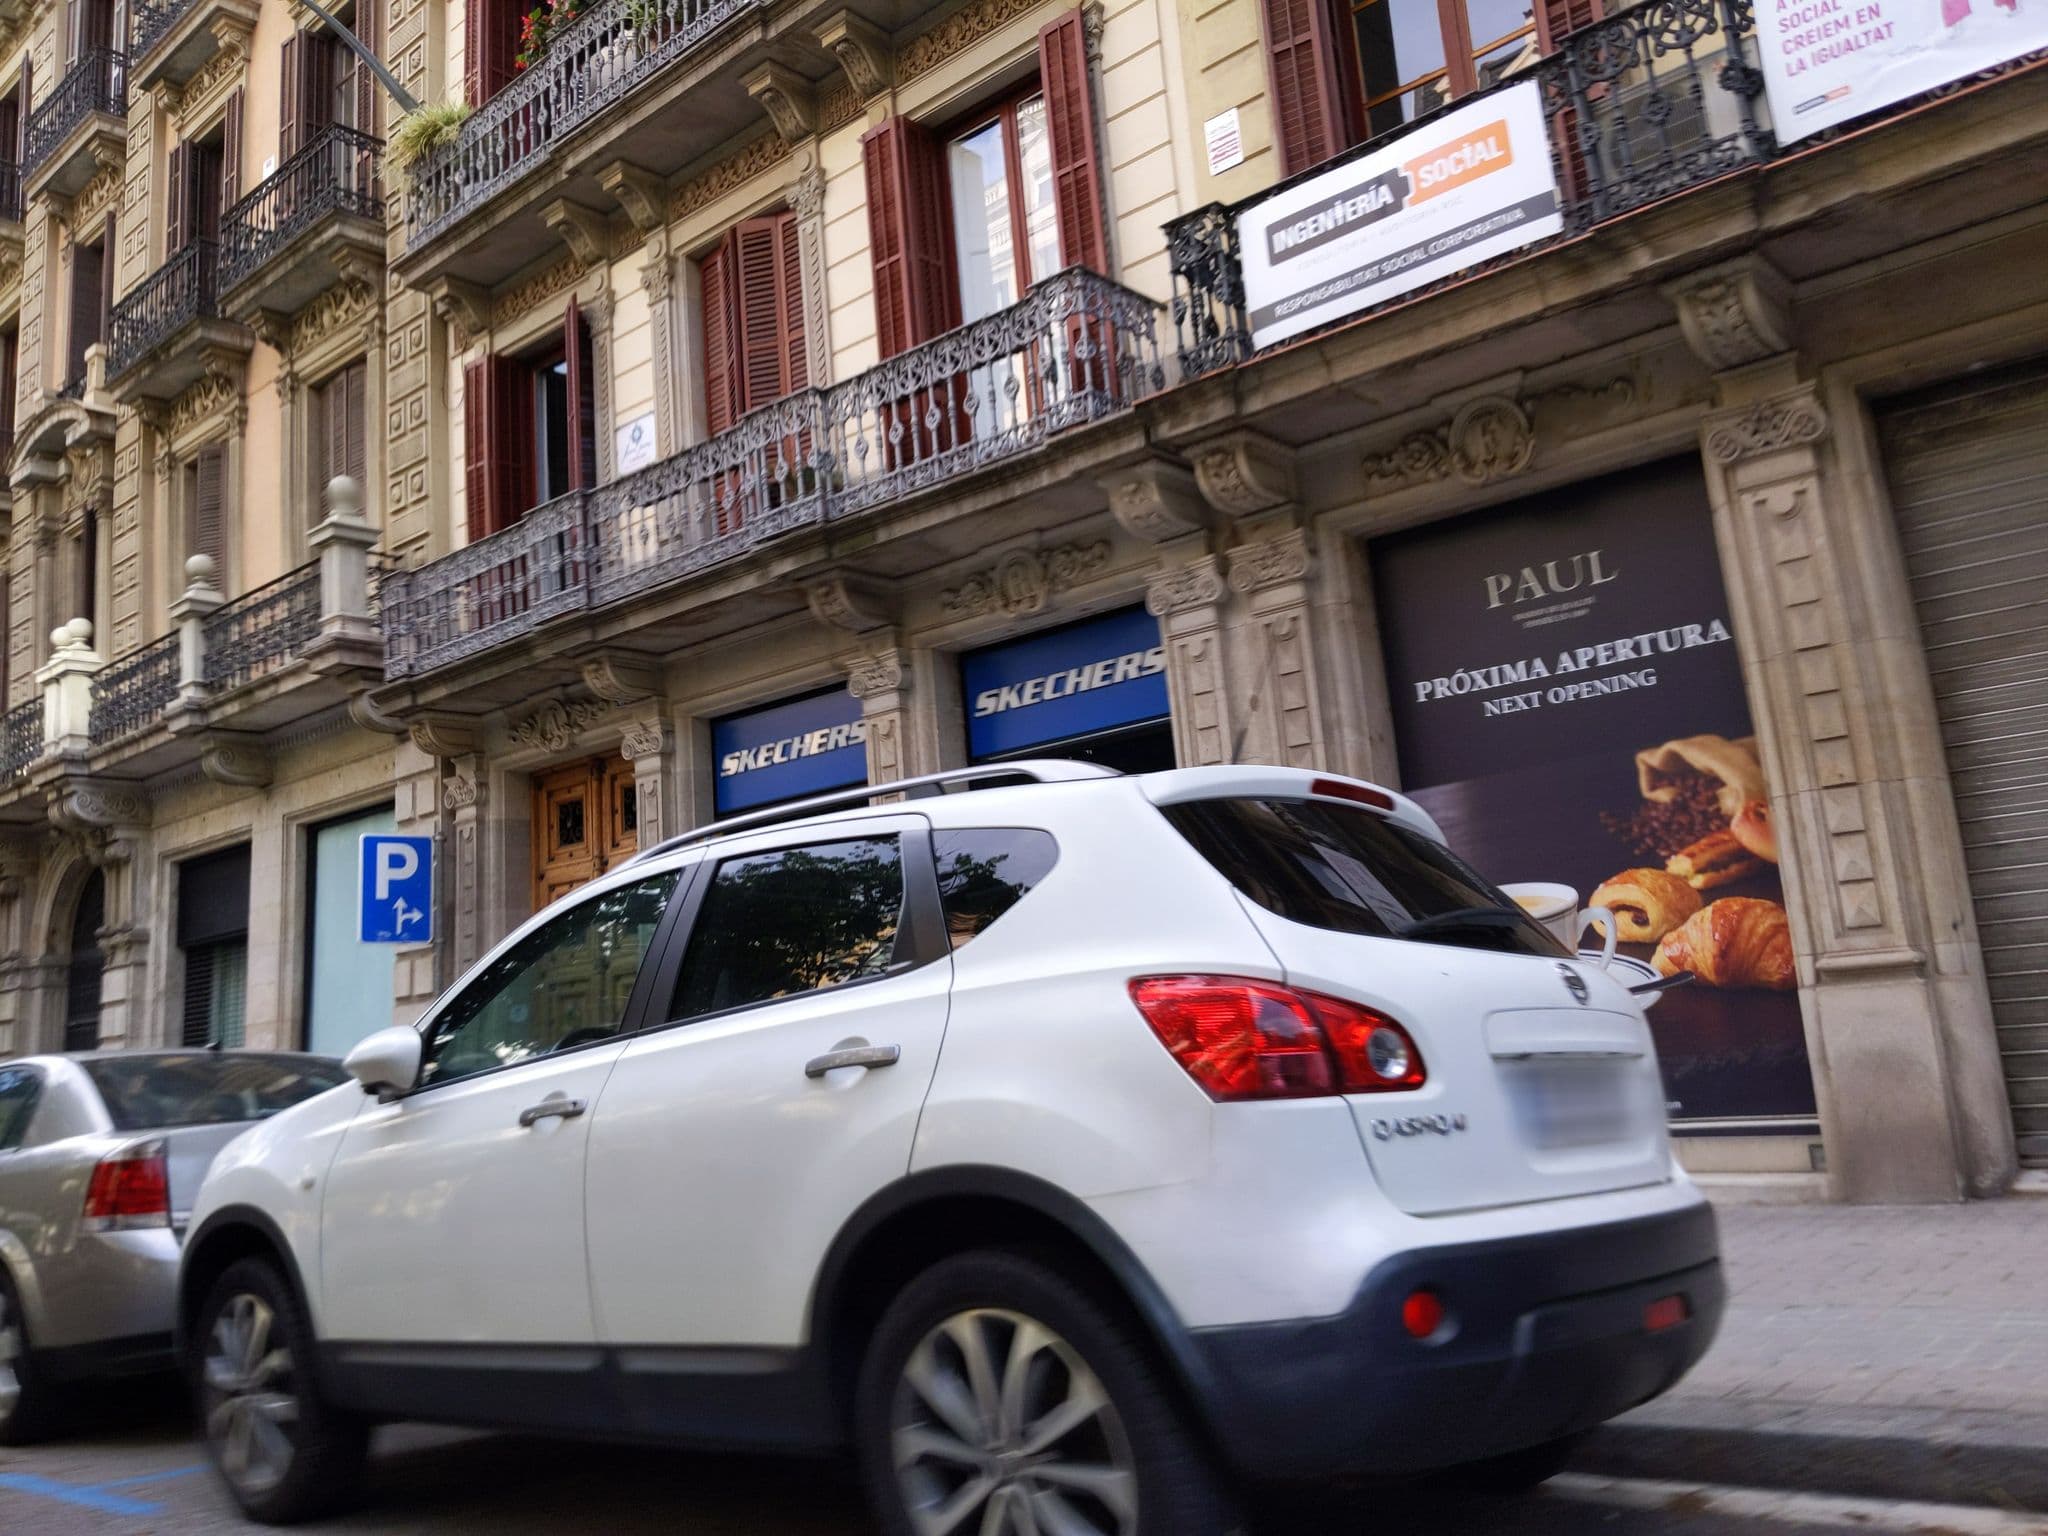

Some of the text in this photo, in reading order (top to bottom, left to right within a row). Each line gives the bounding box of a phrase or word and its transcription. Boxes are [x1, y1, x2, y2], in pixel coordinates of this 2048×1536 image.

[1778, 0, 1842, 33] SOCIAL
[1782, 3, 1881, 54] CREIEM EN
[1786, 22, 1894, 77] LA IGUALTAT
[1418, 135, 1505, 189] SOCIAL
[1274, 266, 1379, 318] RESPONSABILITAT
[1382, 247, 1430, 275] SOCIAL
[1428, 207, 1526, 254] CORPORATIVA
[1483, 550, 1620, 610] PAUL
[974, 647, 1165, 717] SKECHERS
[1413, 618, 1733, 703] PRÓXIMA APERTURA
[1482, 668, 1657, 717] NEXT OPENING
[720, 721, 867, 777] SKECHERS
[376, 842, 418, 900] P
